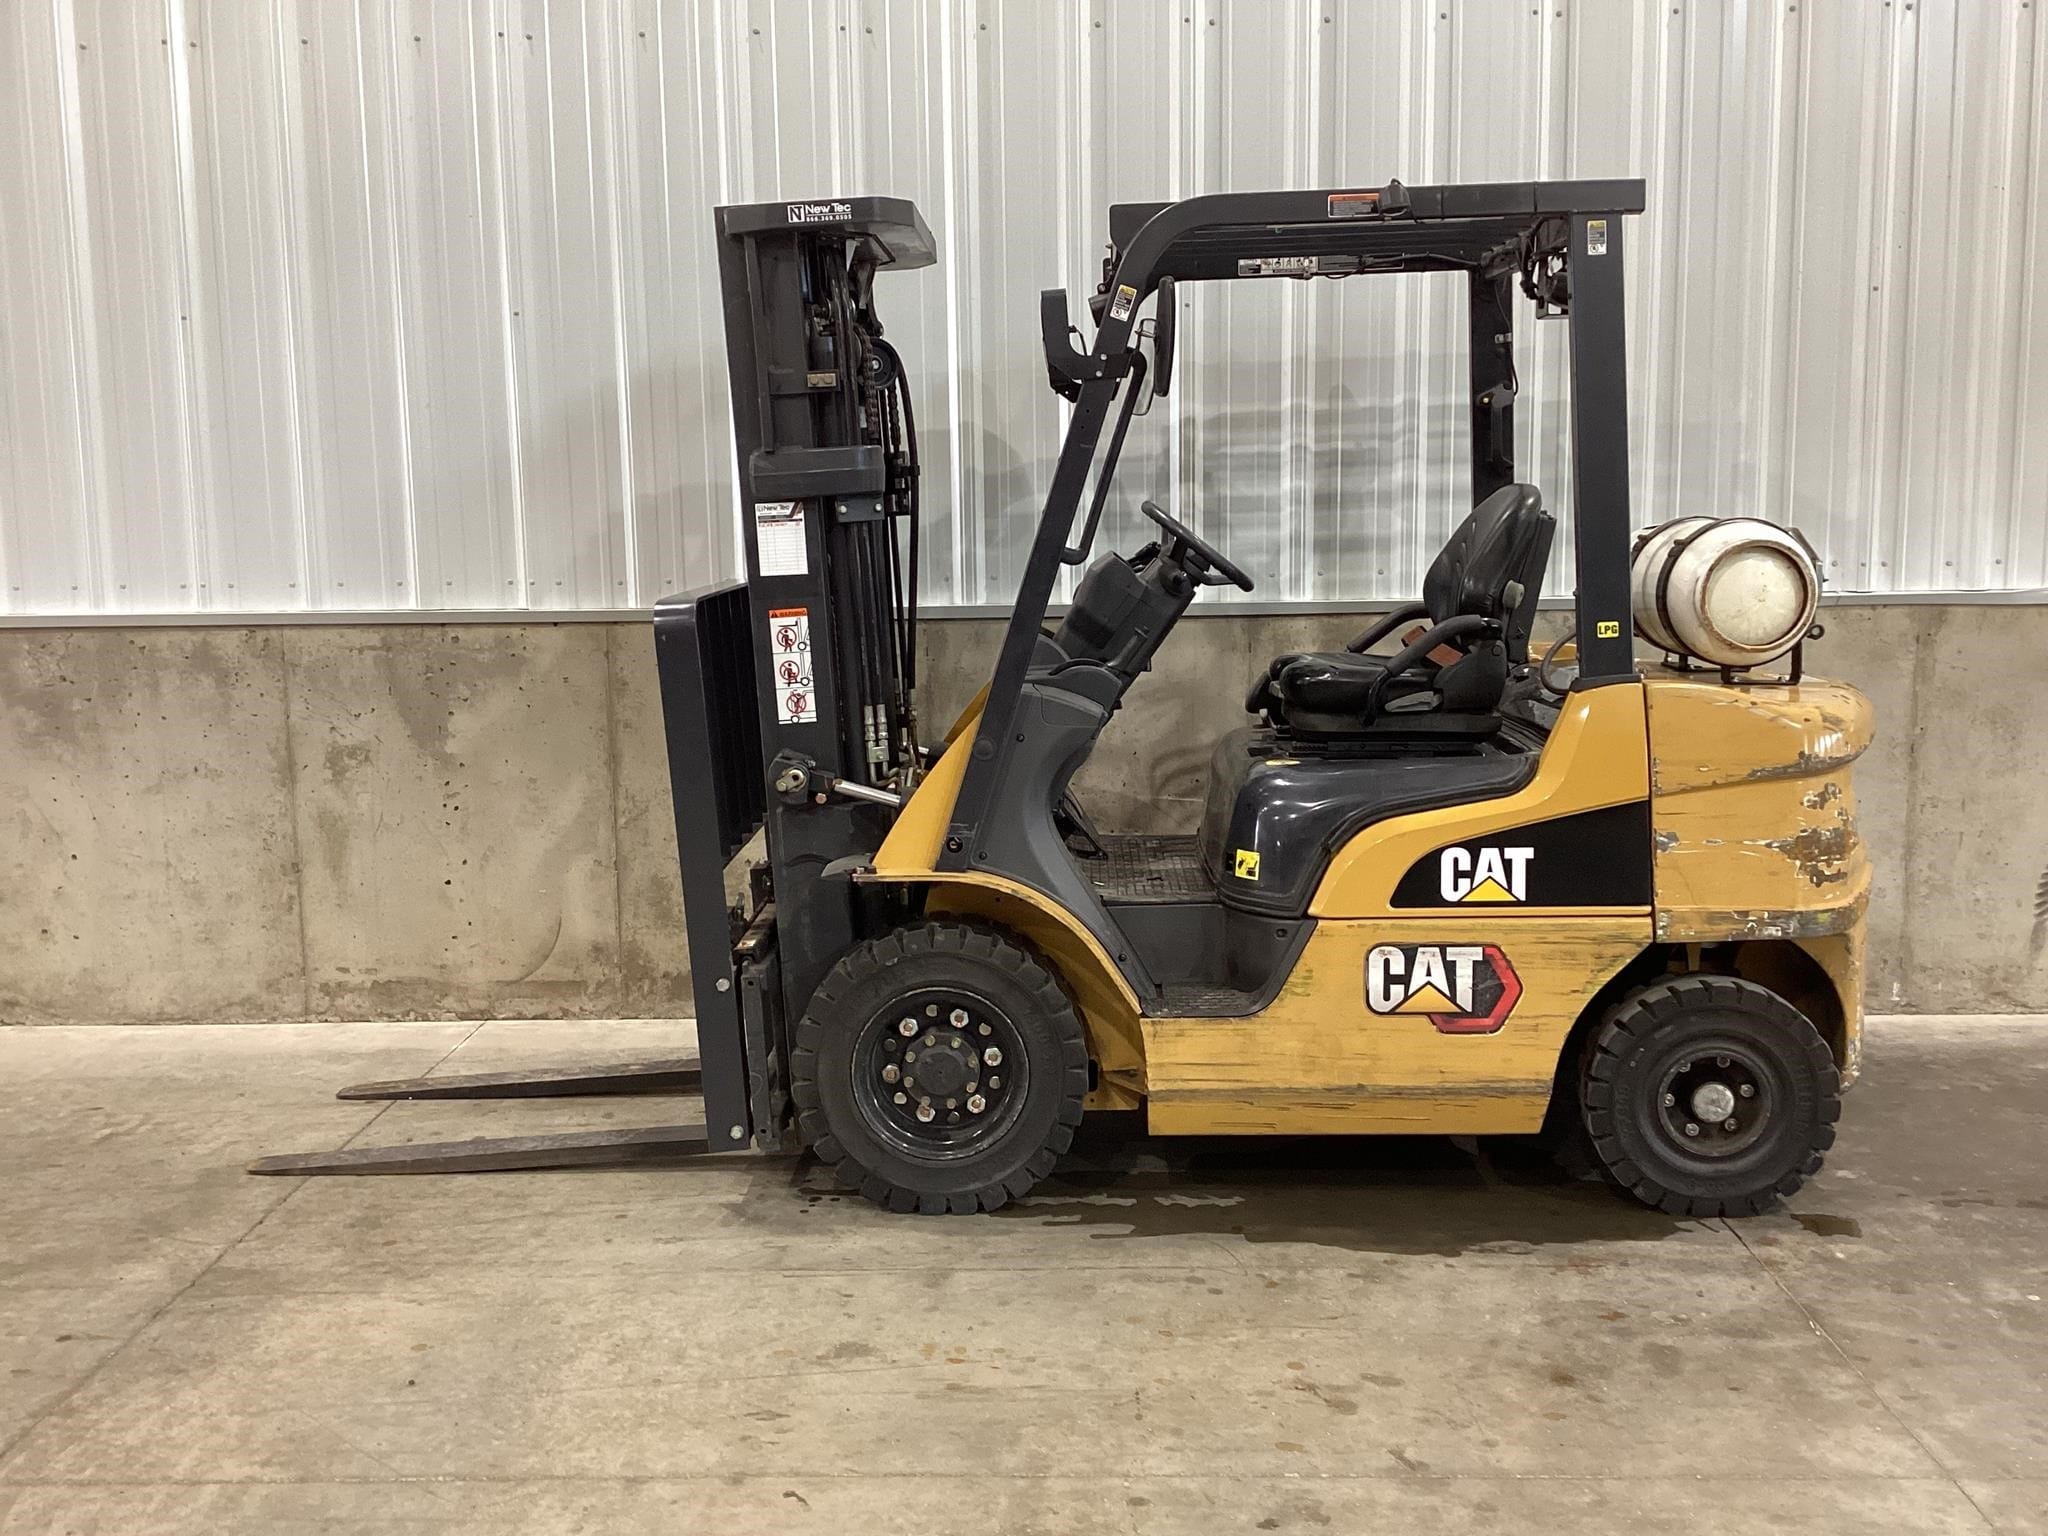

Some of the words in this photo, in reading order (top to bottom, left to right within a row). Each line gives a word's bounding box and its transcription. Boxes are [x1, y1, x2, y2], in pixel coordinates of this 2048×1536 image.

[805, 204, 830, 213] New
[831, 203, 851, 212] Tec
[1599, 625, 1617, 635] LPG
[1440, 847, 1534, 902] CAT
[1369, 946, 1483, 1012] CAT
